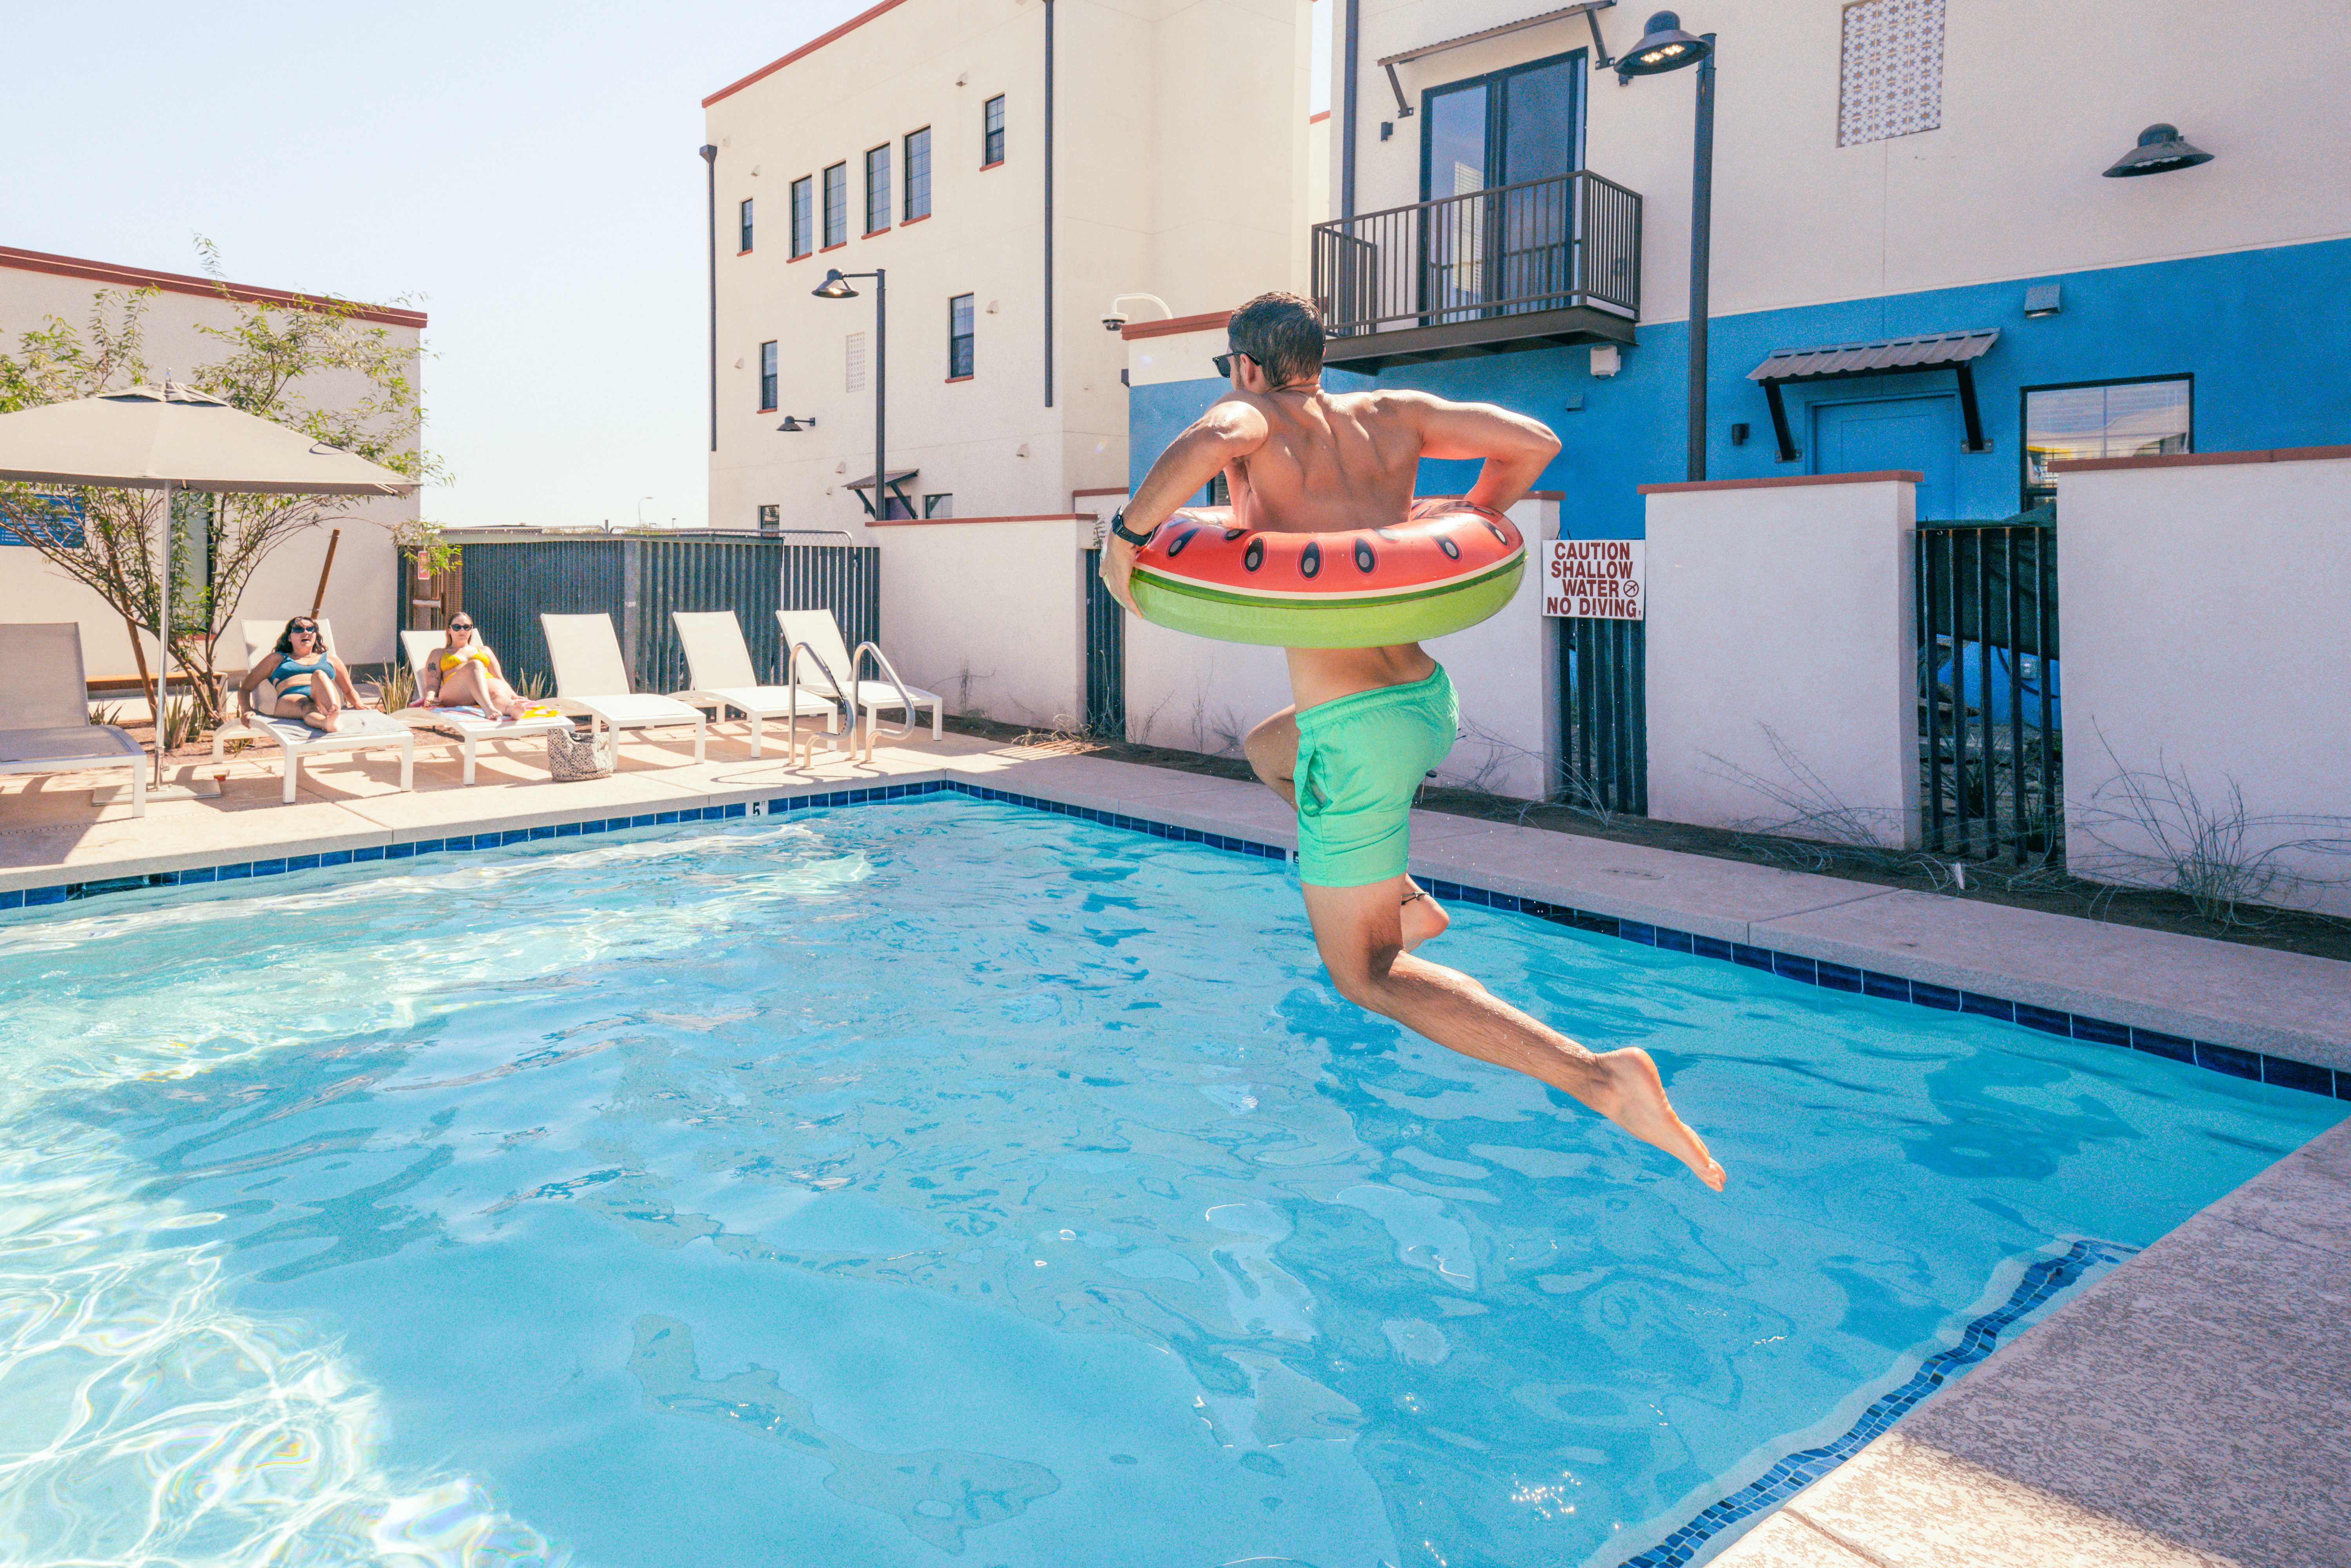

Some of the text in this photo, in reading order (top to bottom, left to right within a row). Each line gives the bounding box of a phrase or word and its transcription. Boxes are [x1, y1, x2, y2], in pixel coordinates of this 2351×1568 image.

[1554, 542, 1630, 560] CAUTION
[1551, 560, 1633, 579] SHALLOW
[1562, 579, 1619, 598] WATER
[1547, 597, 1637, 618] NO DIVING
[753, 802, 760, 817] 5
